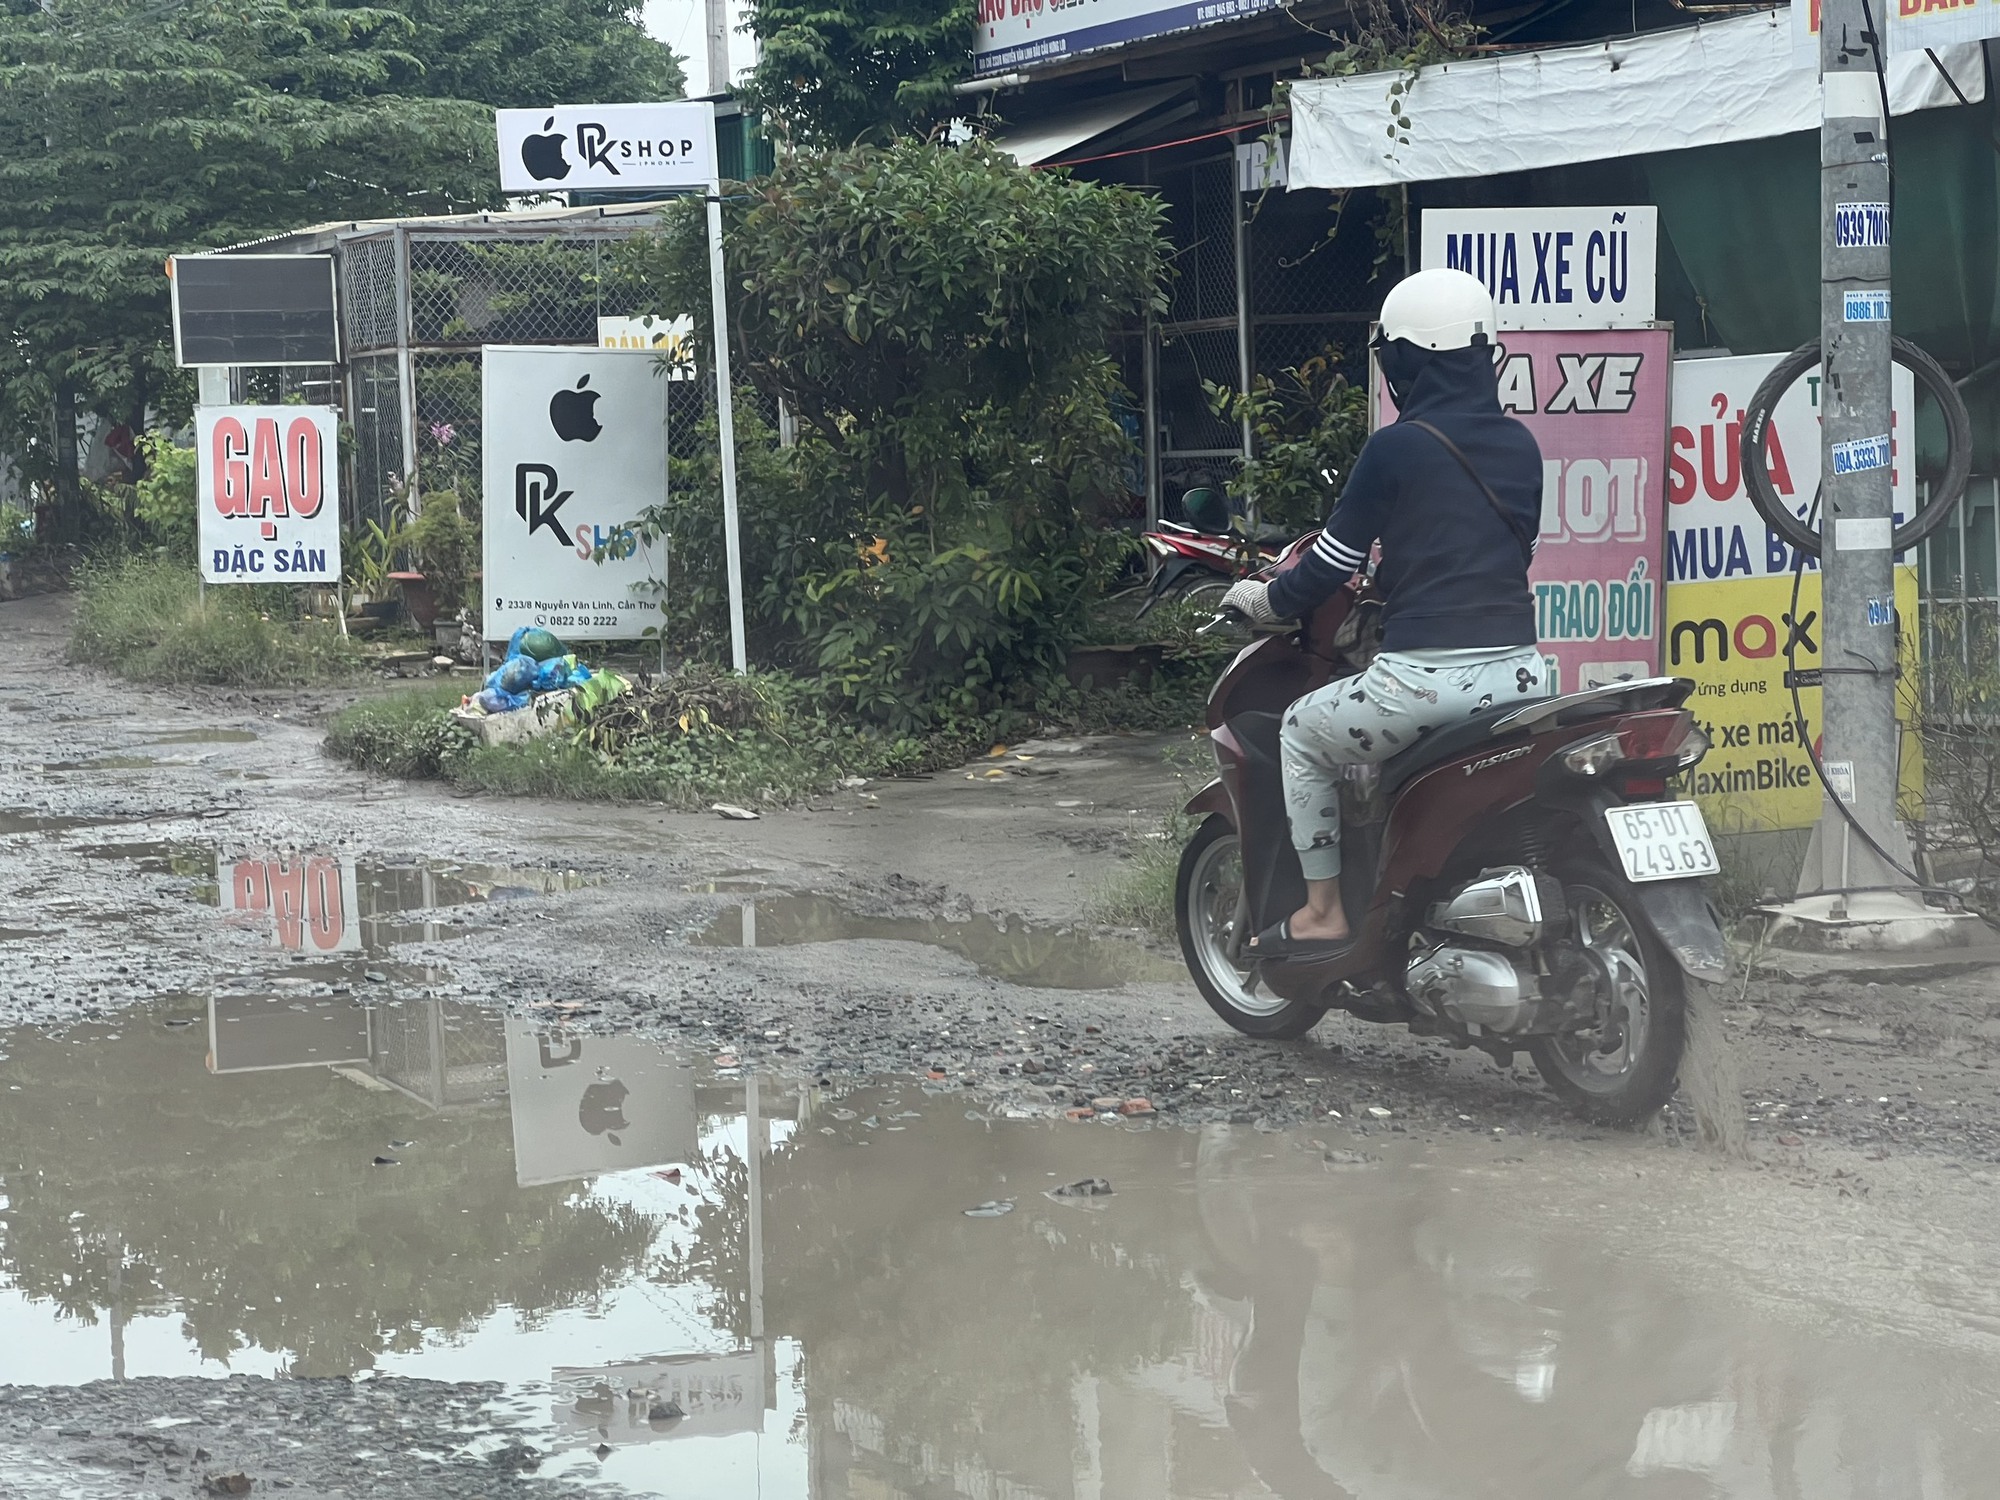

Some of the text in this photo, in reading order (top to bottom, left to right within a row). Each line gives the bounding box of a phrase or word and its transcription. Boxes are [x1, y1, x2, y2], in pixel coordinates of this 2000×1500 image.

[620, 139, 693, 158] SHOP
[1531, 231, 1574, 304] XE
[1586, 211, 1628, 304] CŨ
[1544, 353, 1644, 414] XE
[212, 416, 324, 541] GẠO
[273, 541, 326, 573] SẢN
[1667, 525, 1752, 582] MUA
[508, 600, 533, 610] 233/8
[638, 600, 657, 610] Thơ
[1534, 559, 1652, 639] TRAO ĐỔI
[549, 616, 618, 627] 0822 50 2222
[1698, 679, 1768, 697] ứng dụng
[1721, 723, 1750, 748] xe
[1626, 839, 1713, 877] 249.63
